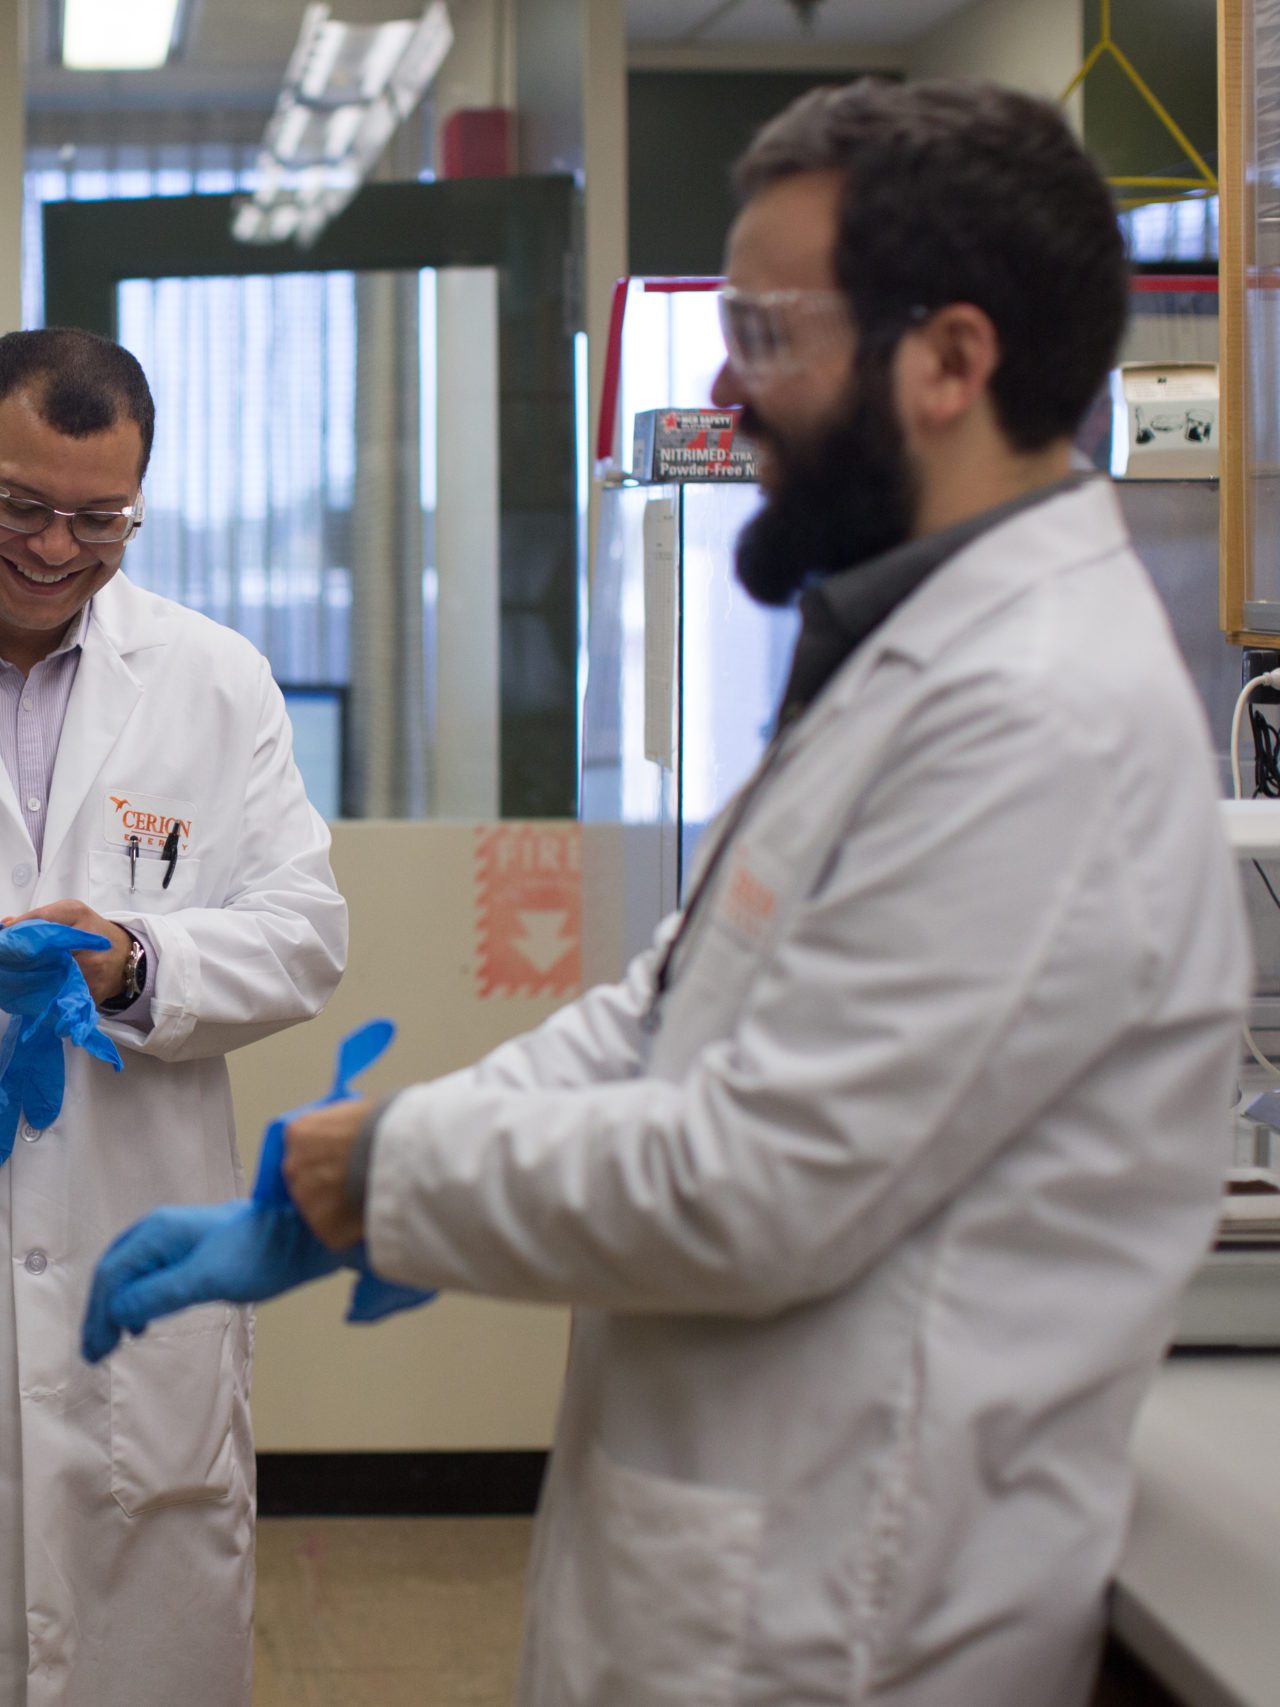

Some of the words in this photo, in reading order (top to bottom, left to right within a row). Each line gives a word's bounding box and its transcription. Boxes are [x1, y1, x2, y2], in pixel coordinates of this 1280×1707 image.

[660, 448, 726, 461] NITRIMED
[660, 463, 742, 476] Powder-Free
[122, 810, 192, 838] CERION
